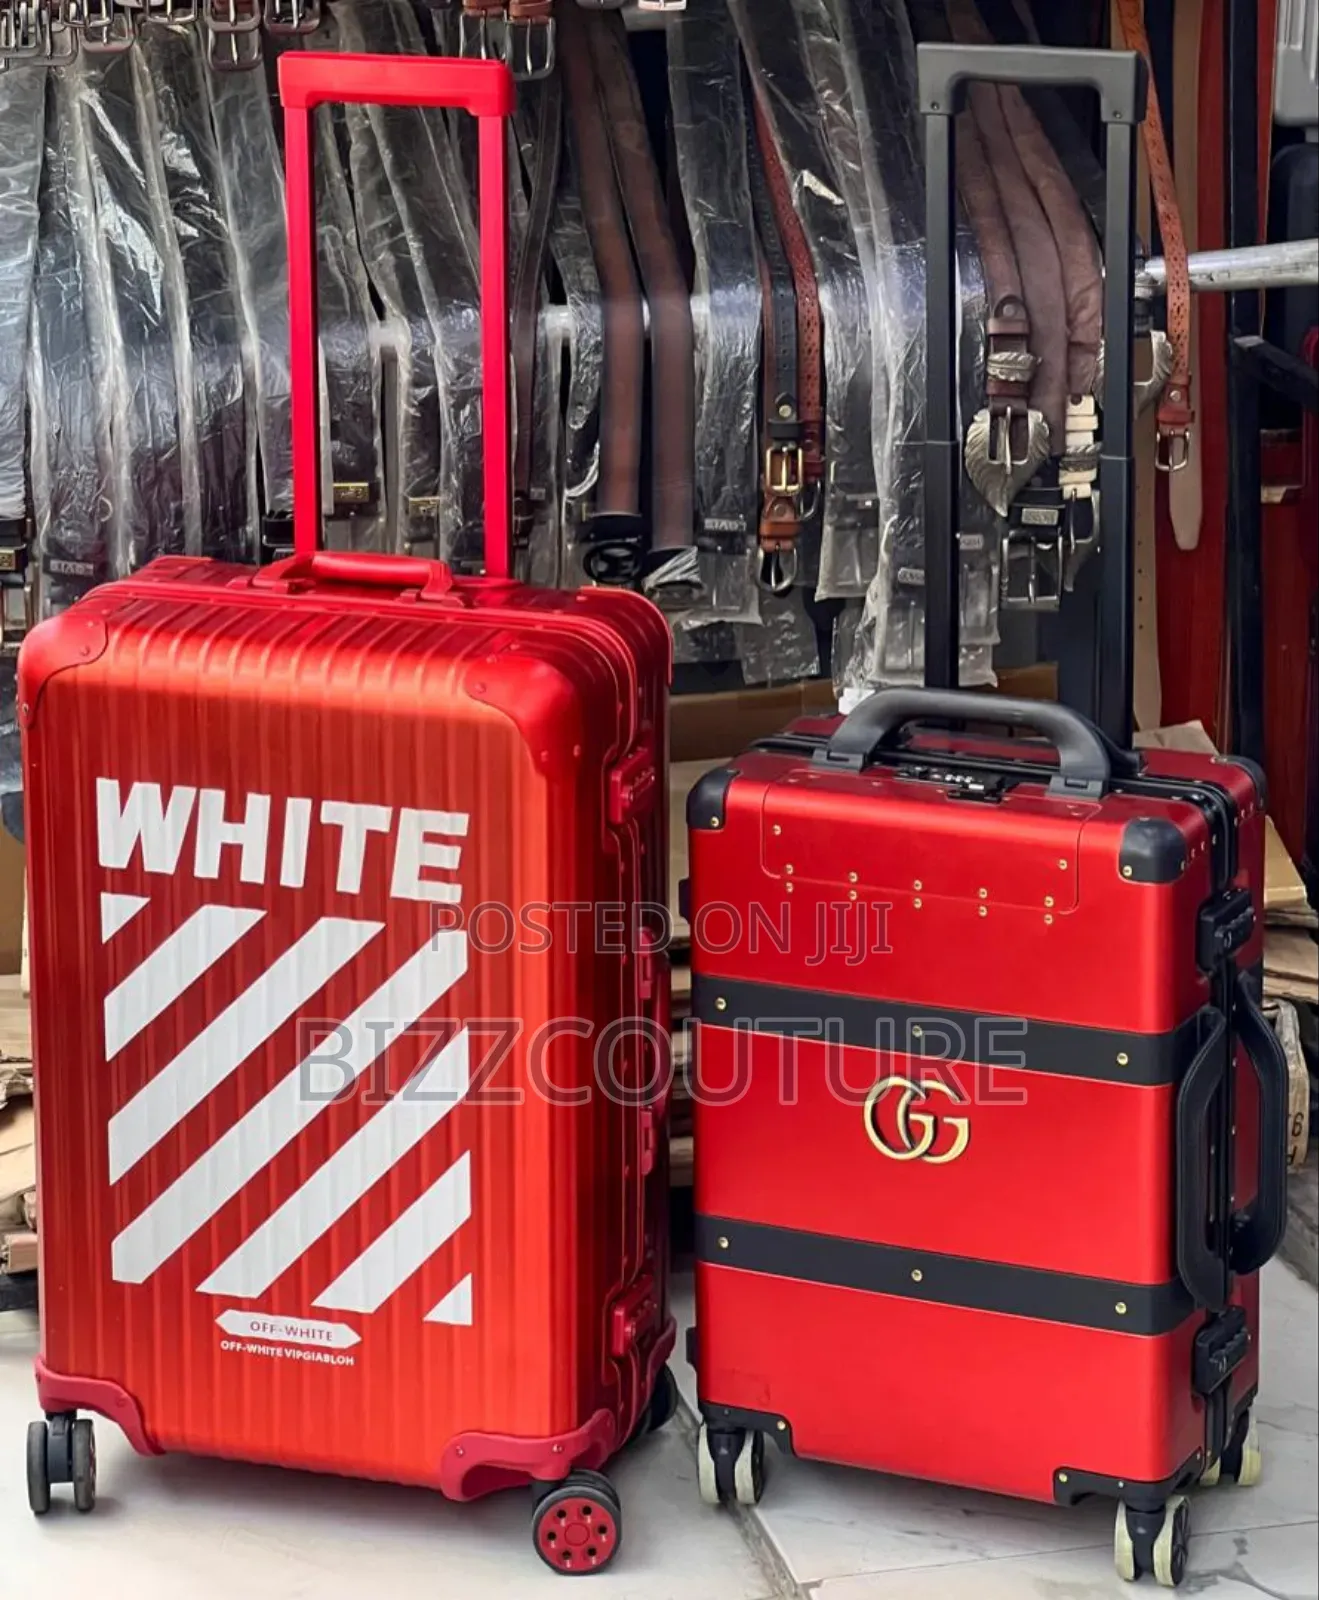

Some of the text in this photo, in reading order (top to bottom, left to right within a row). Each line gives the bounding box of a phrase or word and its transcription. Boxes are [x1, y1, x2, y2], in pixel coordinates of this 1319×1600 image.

[96, 777, 469, 903] WHITE
[250, 1320, 333, 1341] OFF-WHITE
[220, 1340, 283, 1357] OFF-WHITE
